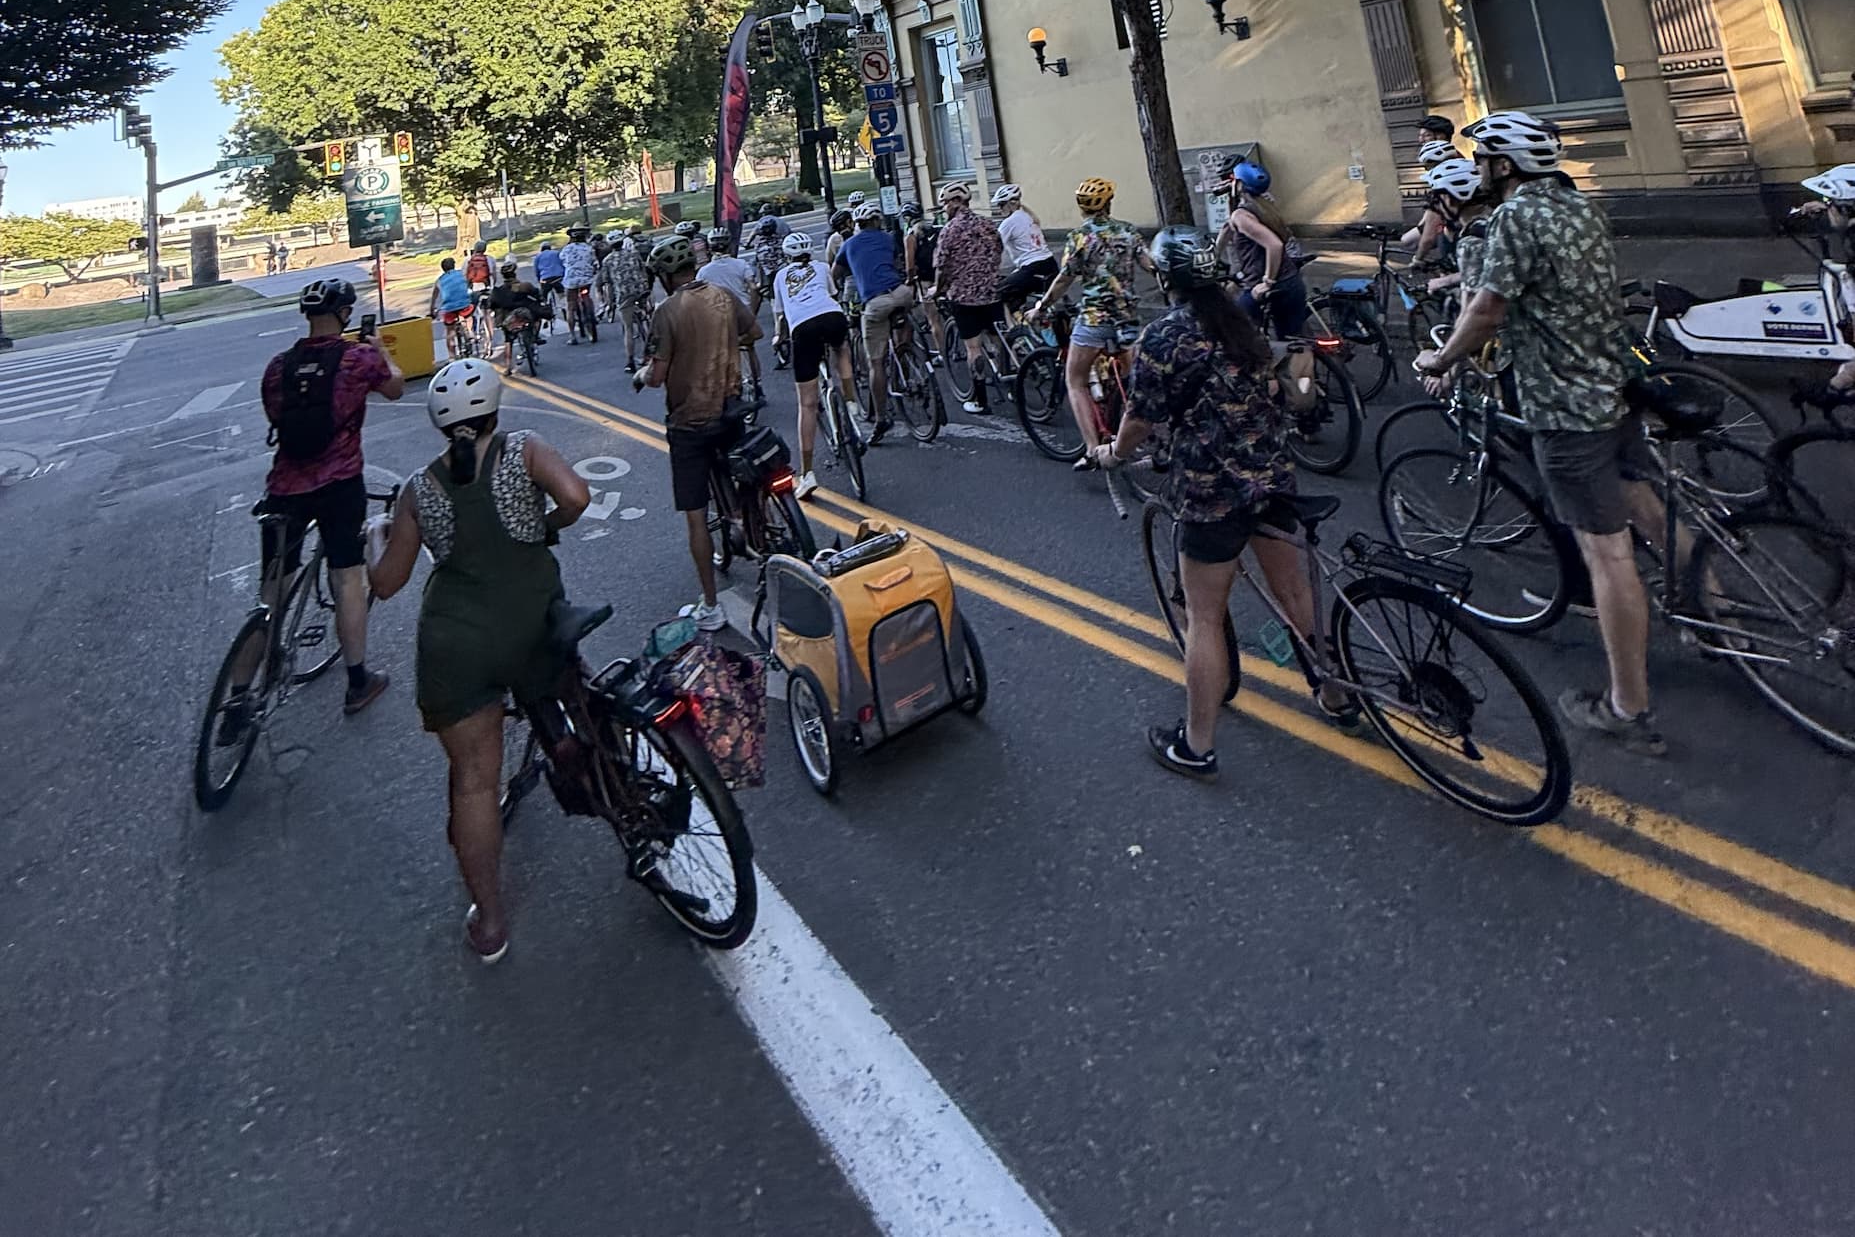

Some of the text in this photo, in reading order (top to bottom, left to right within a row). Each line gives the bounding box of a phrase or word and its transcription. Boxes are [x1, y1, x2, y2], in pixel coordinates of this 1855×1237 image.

[860, 35, 885, 44] TRUCK
[873, 88, 886, 99] TO
[878, 112, 891, 132] 5
[367, 176, 378, 188] P
